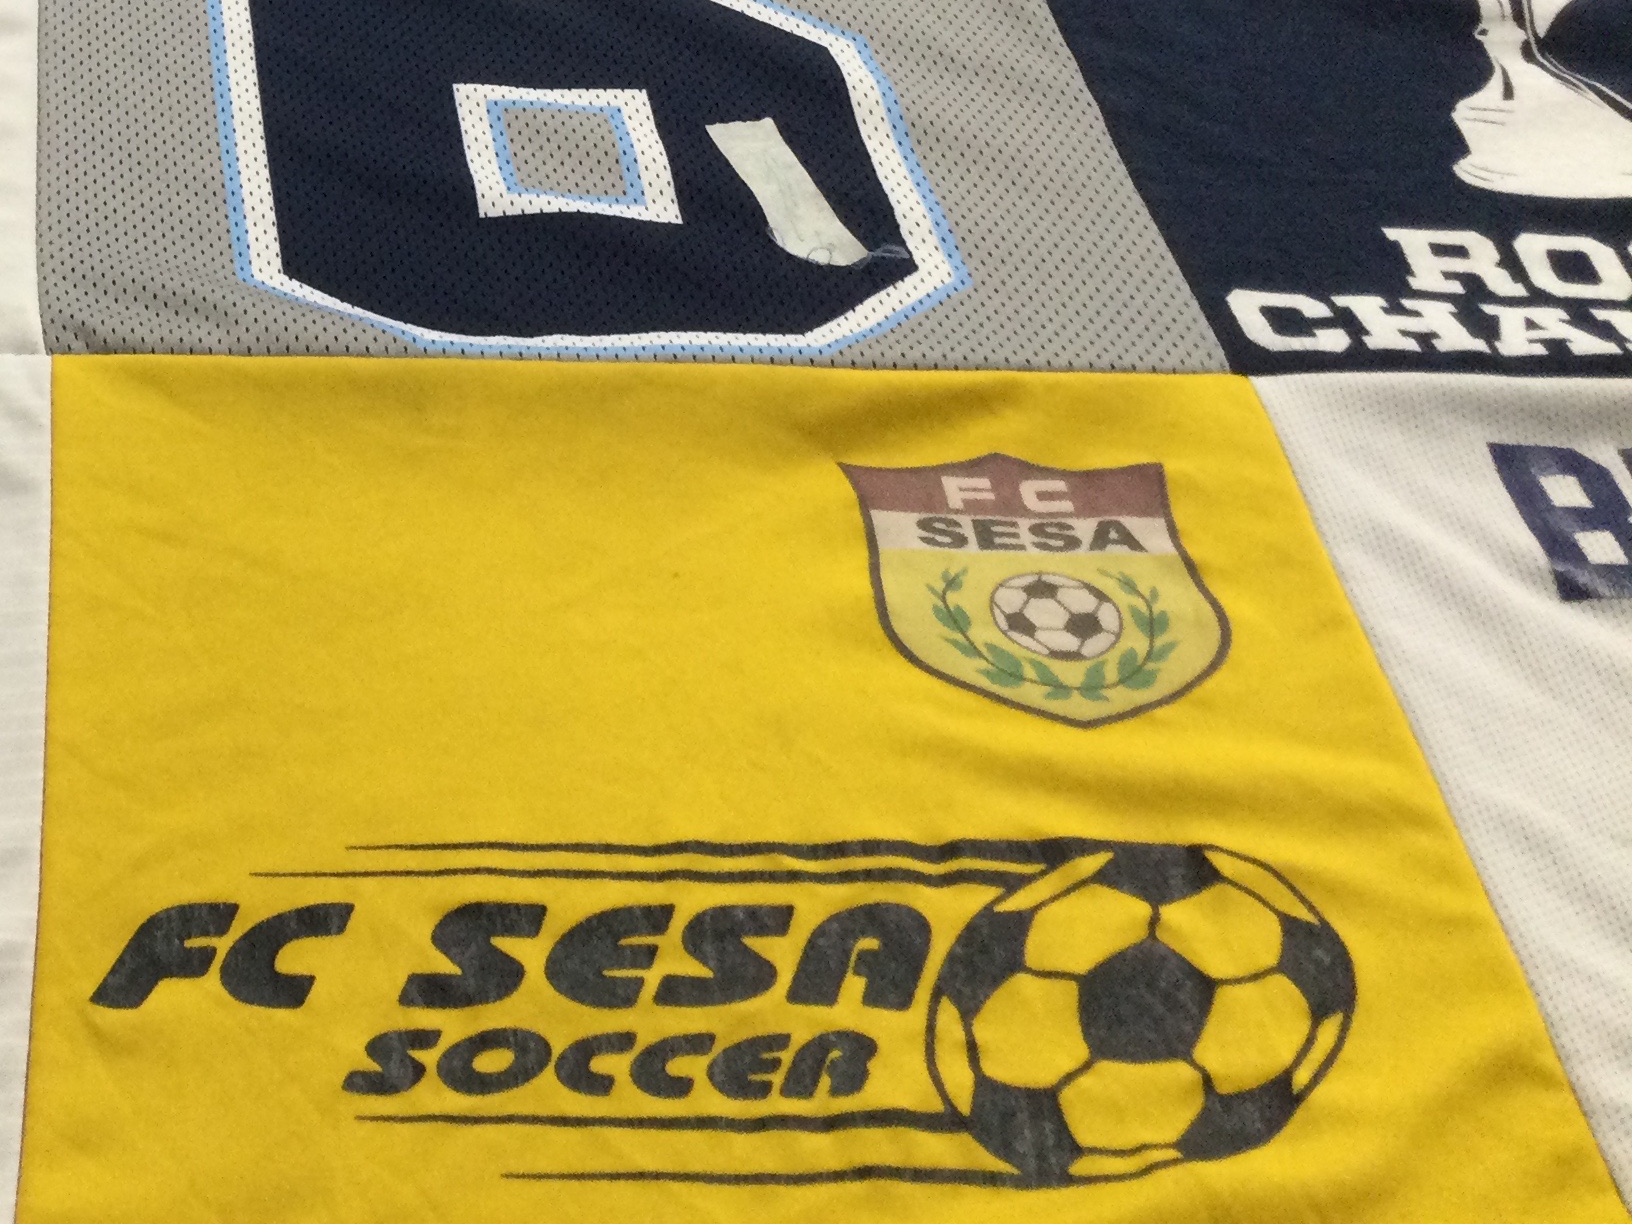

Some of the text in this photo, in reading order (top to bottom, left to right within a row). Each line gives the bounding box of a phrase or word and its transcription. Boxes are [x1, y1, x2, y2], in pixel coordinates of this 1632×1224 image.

[940, 475, 1076, 515] FC
[915, 515, 1150, 554] SESA
[88, 900, 934, 1012] FC SESA
[341, 1026, 879, 1101] SOCCER
